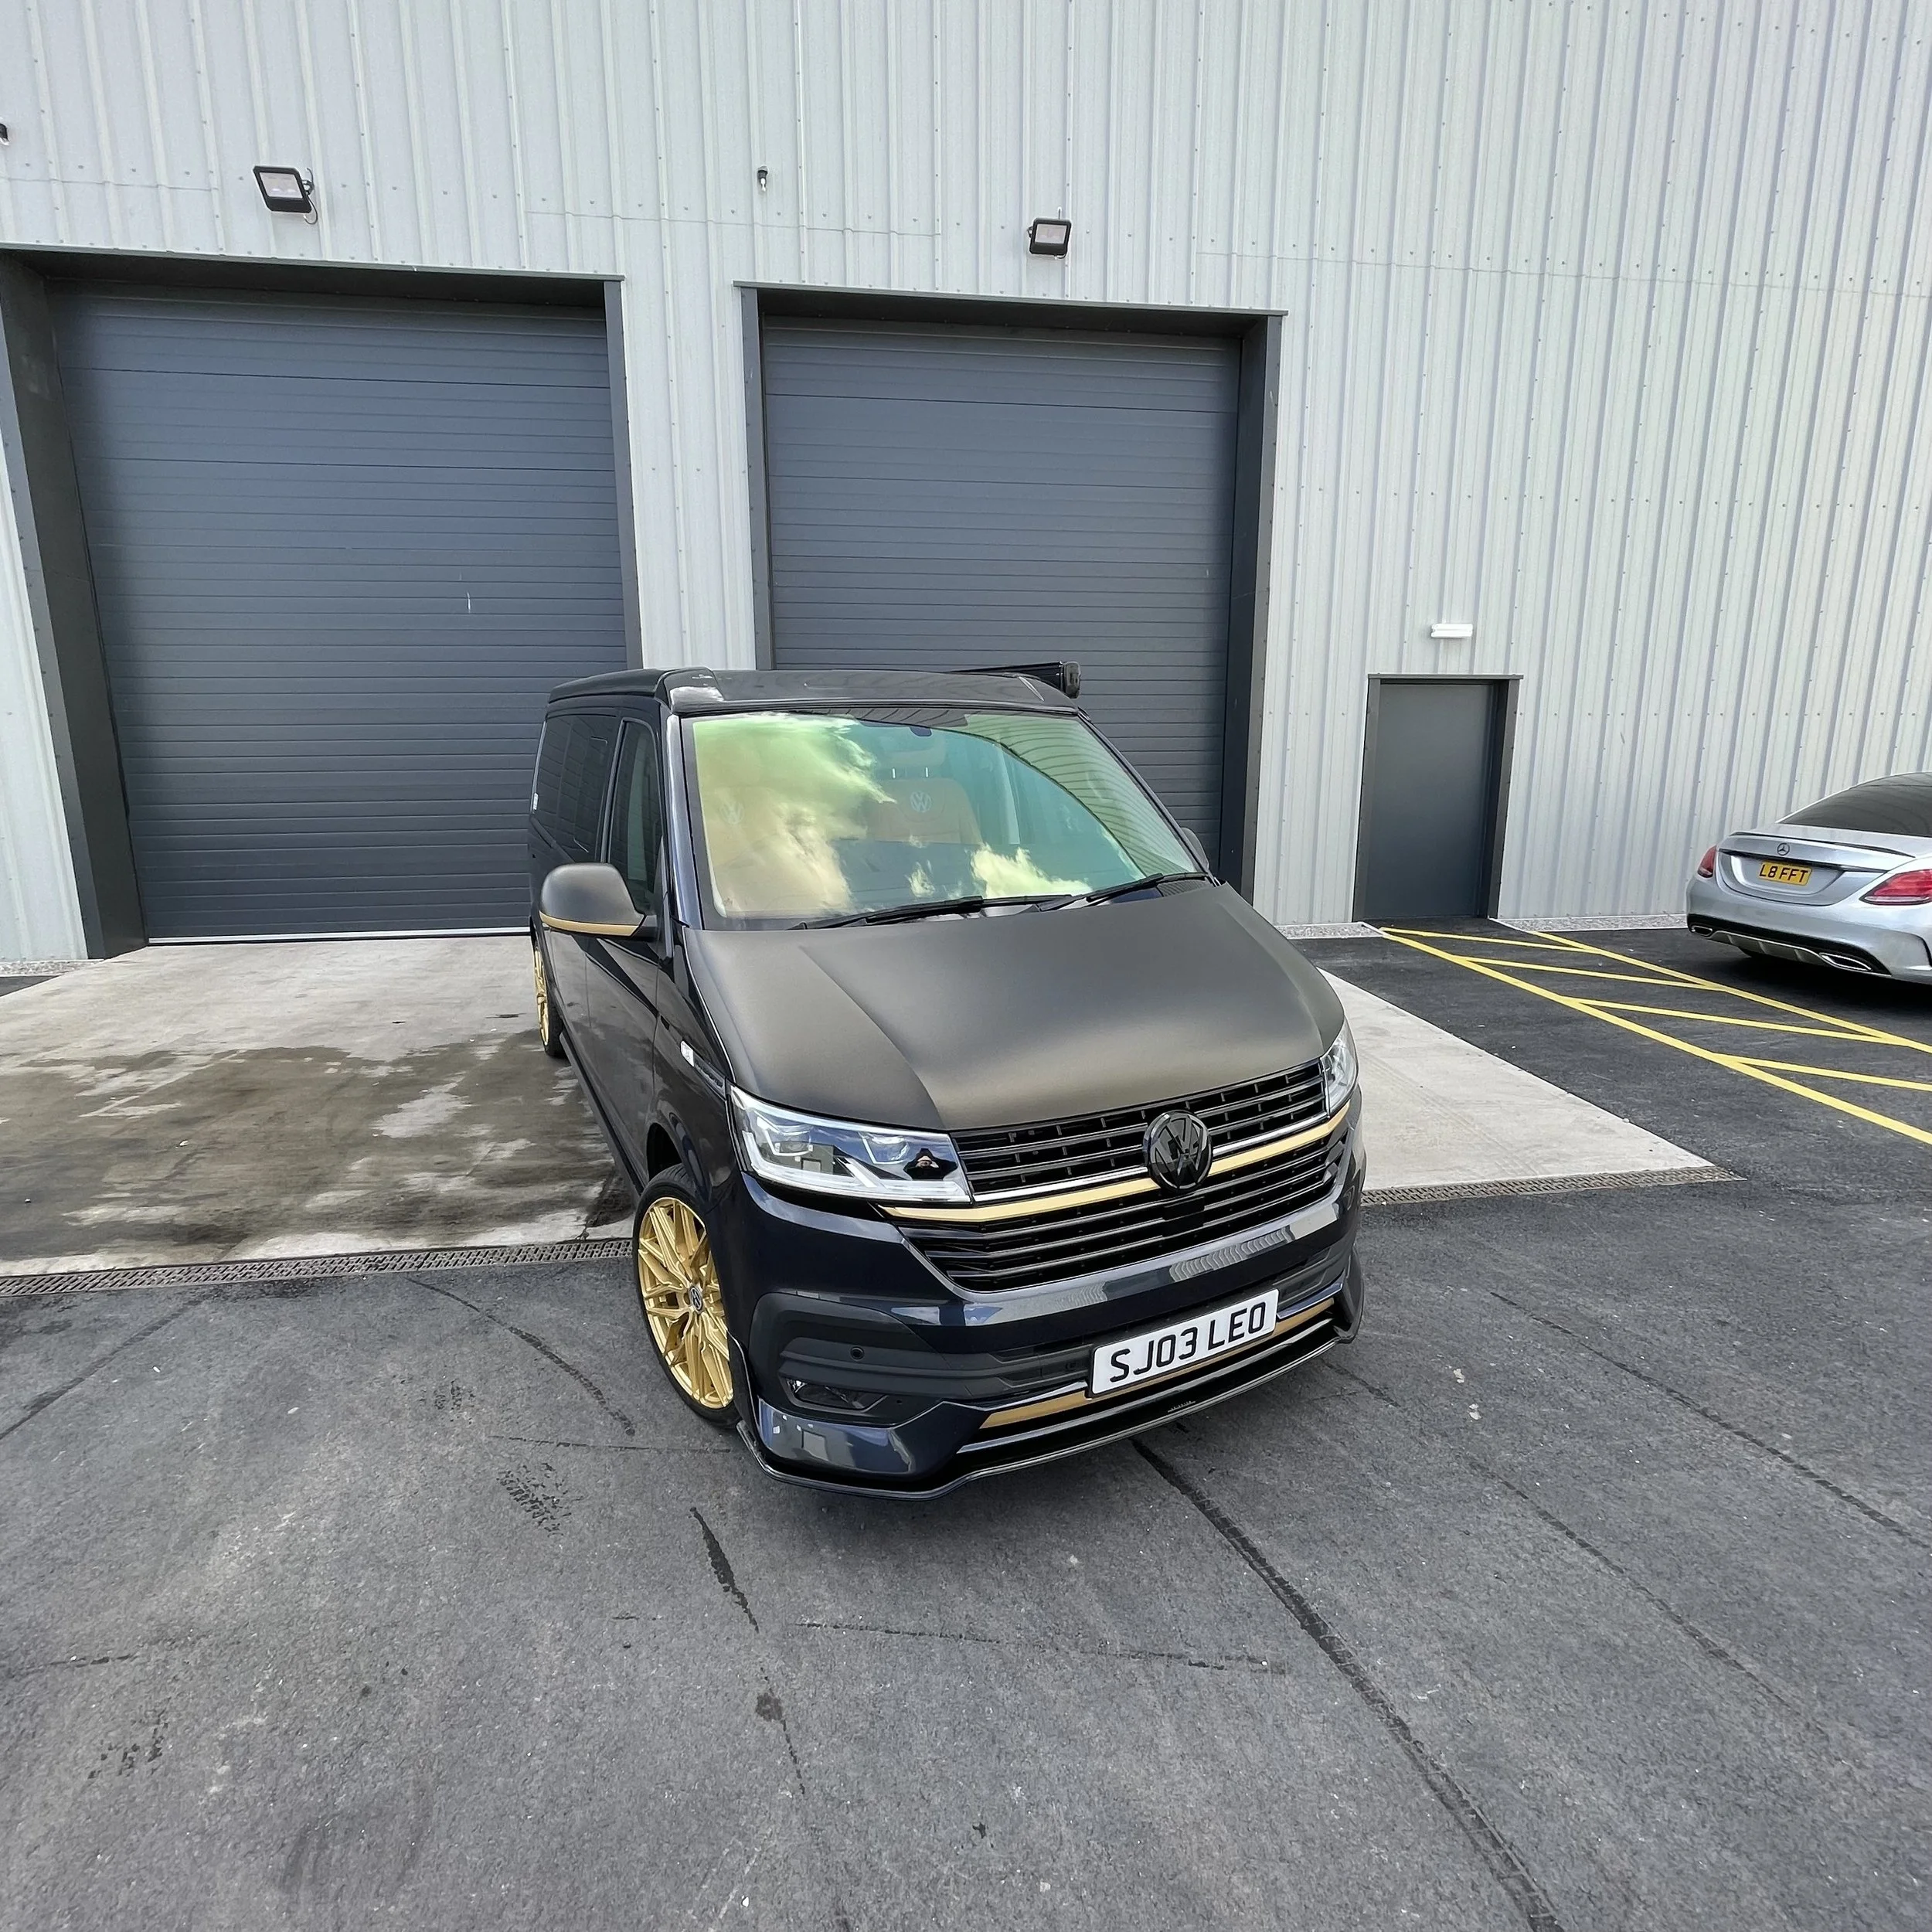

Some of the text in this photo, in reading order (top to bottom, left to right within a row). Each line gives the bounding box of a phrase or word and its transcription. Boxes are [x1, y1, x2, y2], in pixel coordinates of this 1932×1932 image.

[1759, 864, 1808, 883] L8 FFT
[1110, 1301, 1266, 1383] SJ03 LEO
